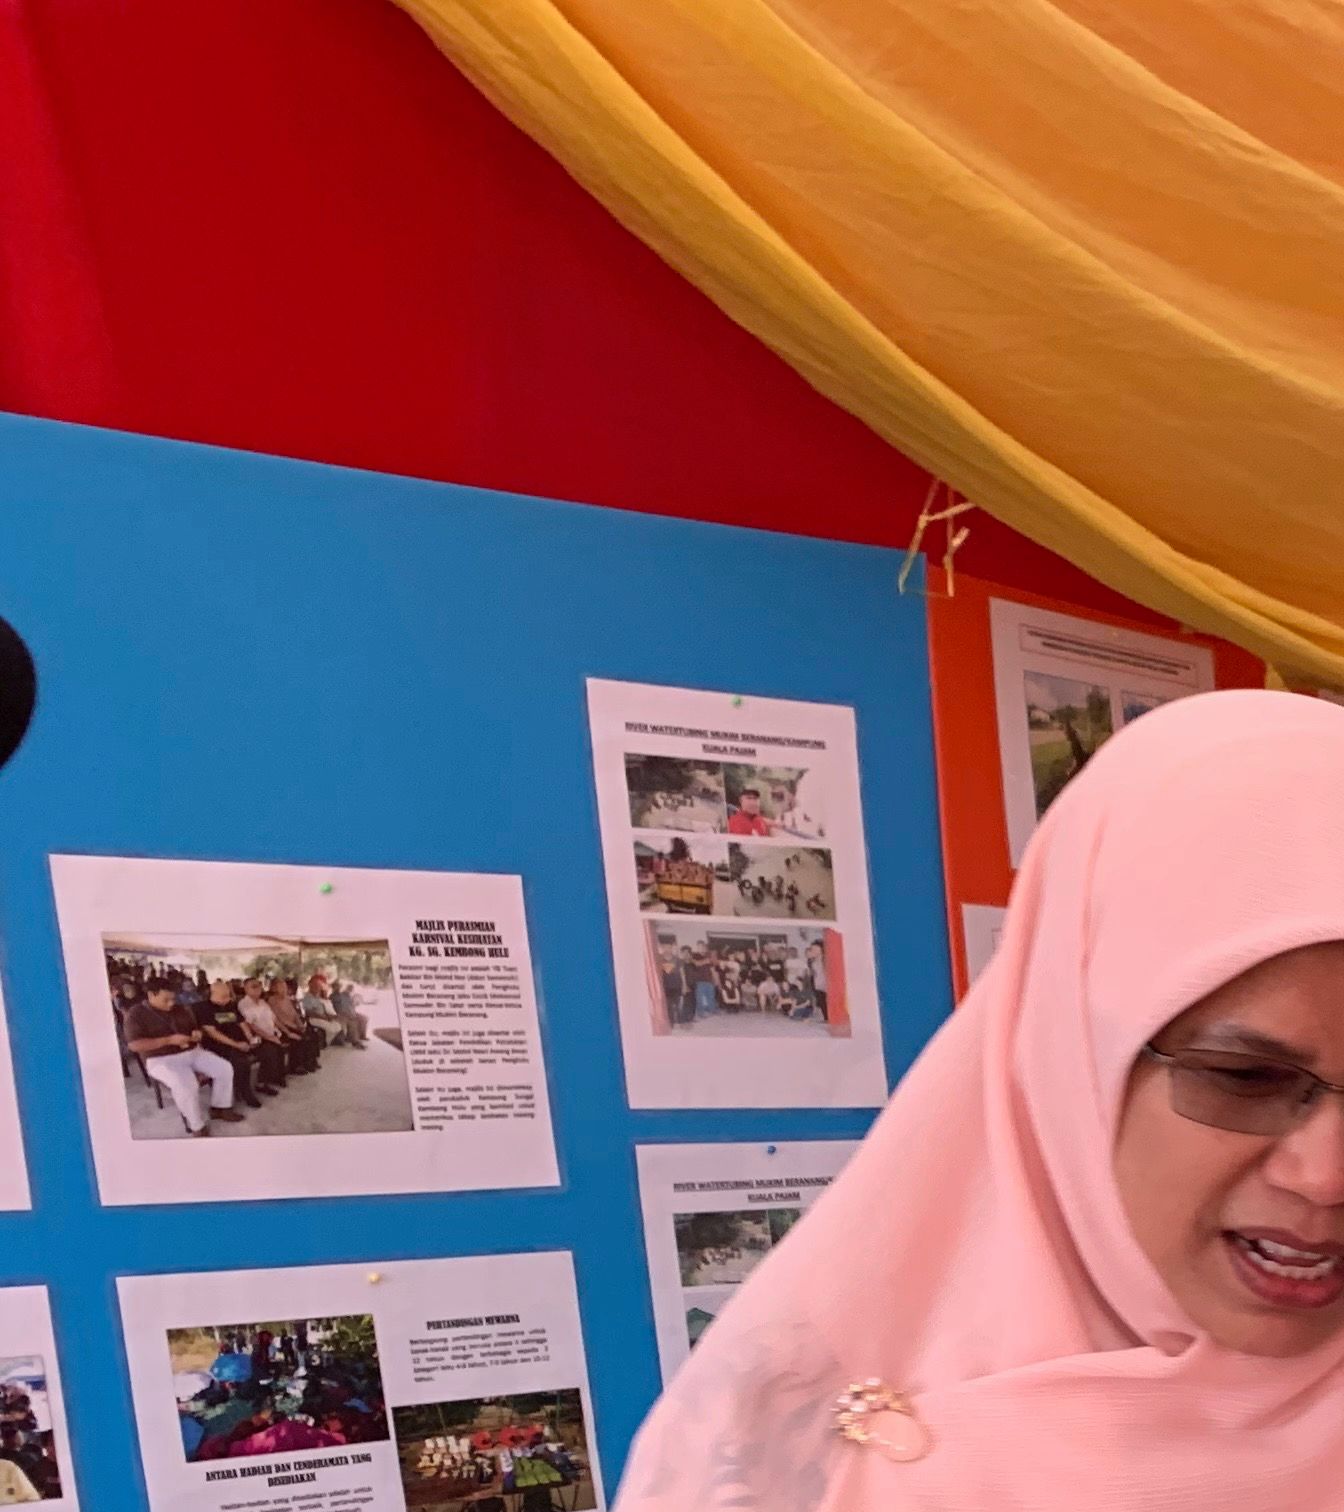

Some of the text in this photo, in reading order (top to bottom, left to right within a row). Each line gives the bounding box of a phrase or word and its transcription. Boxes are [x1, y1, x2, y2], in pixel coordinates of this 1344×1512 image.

[415, 919, 496, 932] MAJLIS PERASMIAN
[412, 932, 503, 945] KARNIVAL KESIHATAN
[409, 946, 426, 957] KG.
[427, 946, 442, 958] SG.
[443, 946, 486, 958] KEMBONG
[747, 1192, 774, 1204] KUALA
[426, 1317, 484, 1330] PERTANDINGAN
[205, 1453, 372, 1482] ANTARA HADIAH DAN CENDERAMATA YANG
[267, 1471, 317, 1487] DISEDIAKAN
